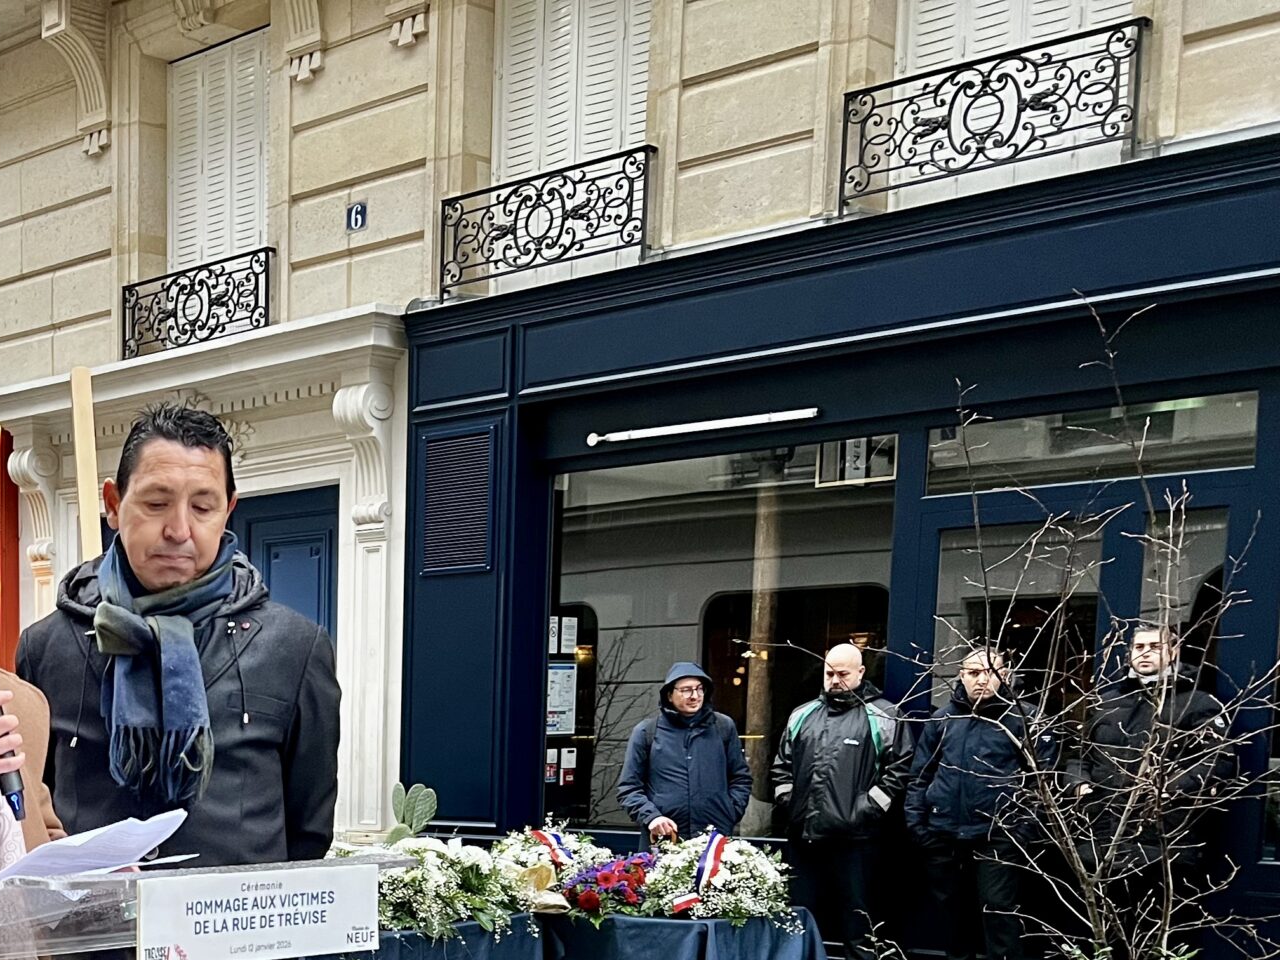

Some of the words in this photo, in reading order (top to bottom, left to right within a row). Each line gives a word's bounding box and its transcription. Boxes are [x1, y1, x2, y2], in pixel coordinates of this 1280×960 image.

[351, 204, 362, 229] 6
[241, 882, 283, 892] Cérémonie
[186, 898, 249, 917] HOMMAGE
[251, 895, 277, 911] AUX
[279, 890, 335, 908] VICTIMES
[194, 920, 211, 935] DE
[213, 918, 229, 933] LA
[232, 916, 256, 932] RUE
[260, 914, 275, 929] DE
[277, 908, 327, 927] TRÉVISE
[346, 930, 375, 944] NEUF
